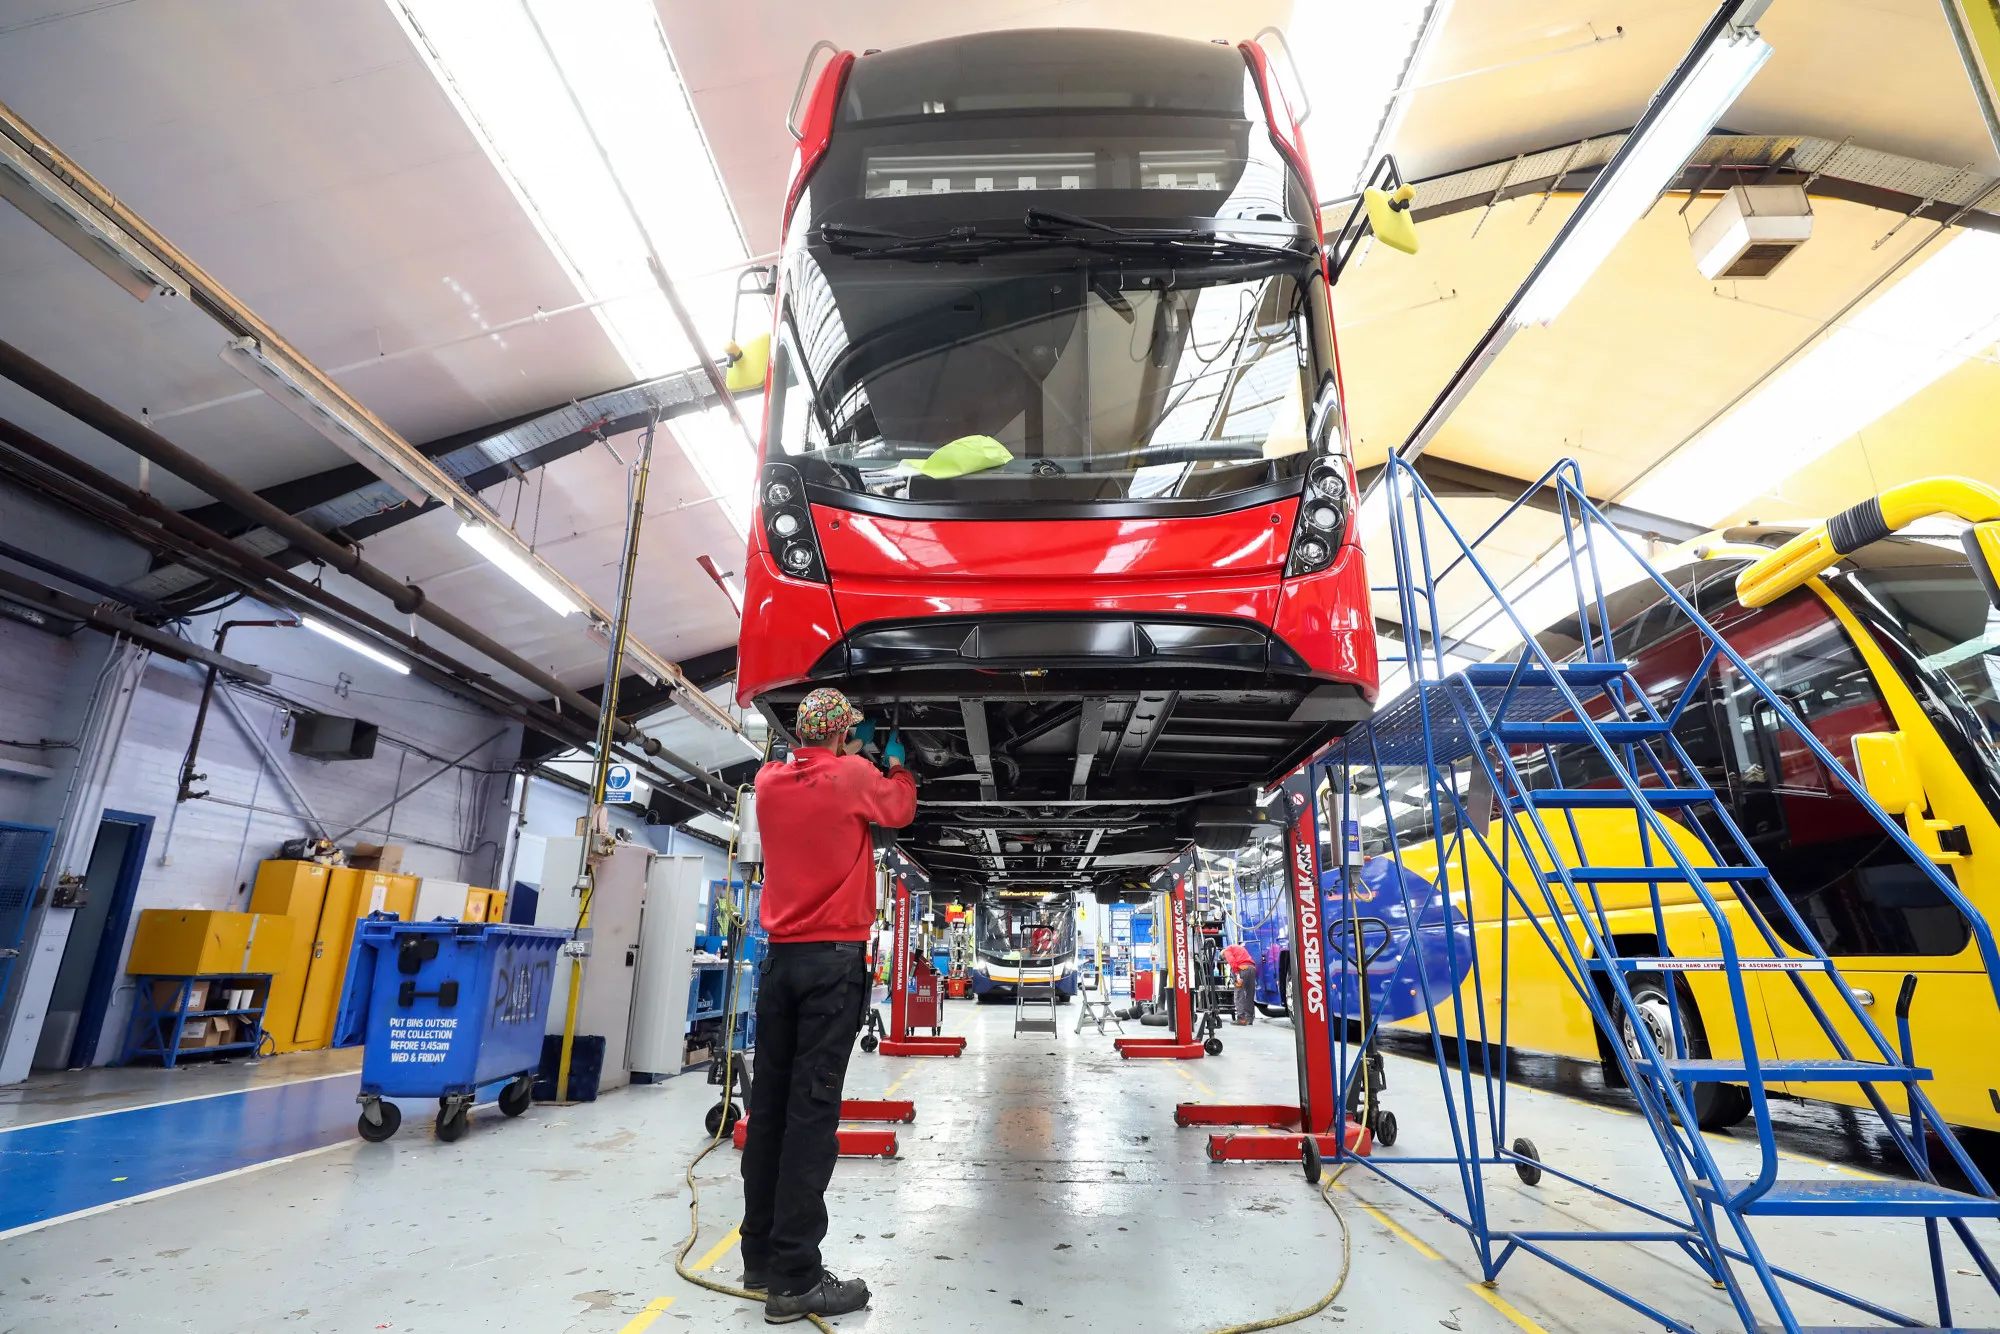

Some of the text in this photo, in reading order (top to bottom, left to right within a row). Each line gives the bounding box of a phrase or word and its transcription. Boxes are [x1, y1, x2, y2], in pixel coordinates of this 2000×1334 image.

[896, 897, 906, 991] www.somerstotalkare.co.uk
[390, 1018, 458, 1028] PUT BINS OUTSIDE
[391, 1029, 453, 1039] FOR COLLECTION
[390, 1040, 419, 1050] BEFORE
[391, 1052, 446, 1063] WED & FRIDAY
